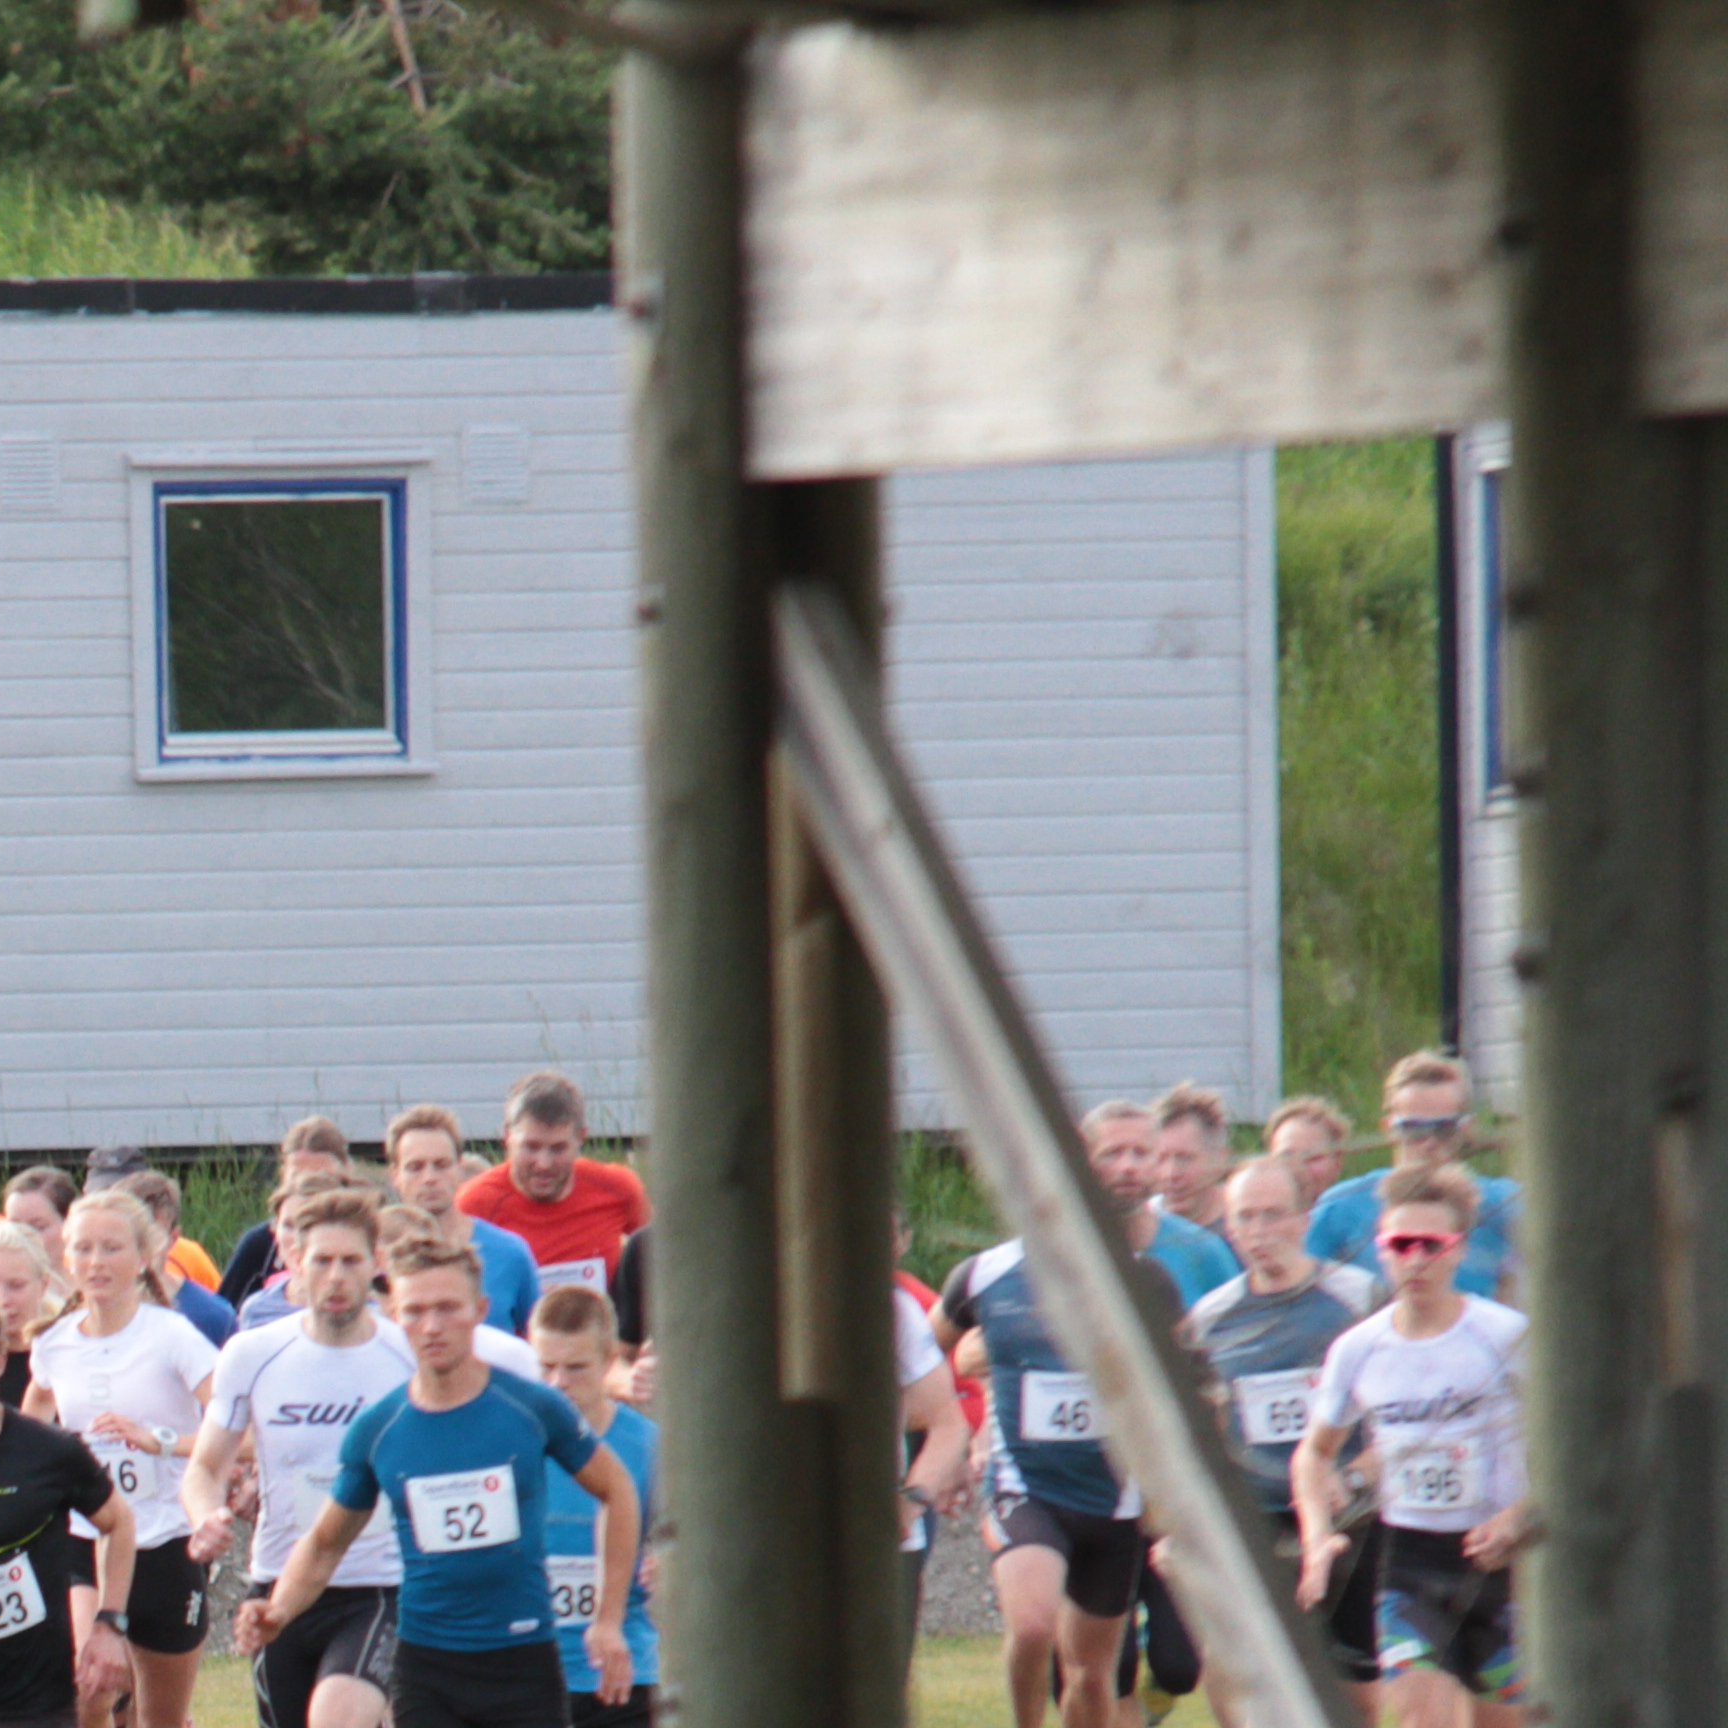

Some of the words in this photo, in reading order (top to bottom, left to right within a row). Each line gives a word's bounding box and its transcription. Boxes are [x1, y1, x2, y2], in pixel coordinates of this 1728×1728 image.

[268, 1397, 364, 1424] swi
[1050, 1400, 1091, 1433] 46
[444, 1502, 489, 1542] 52
[552, 1585, 595, 1617] 38
